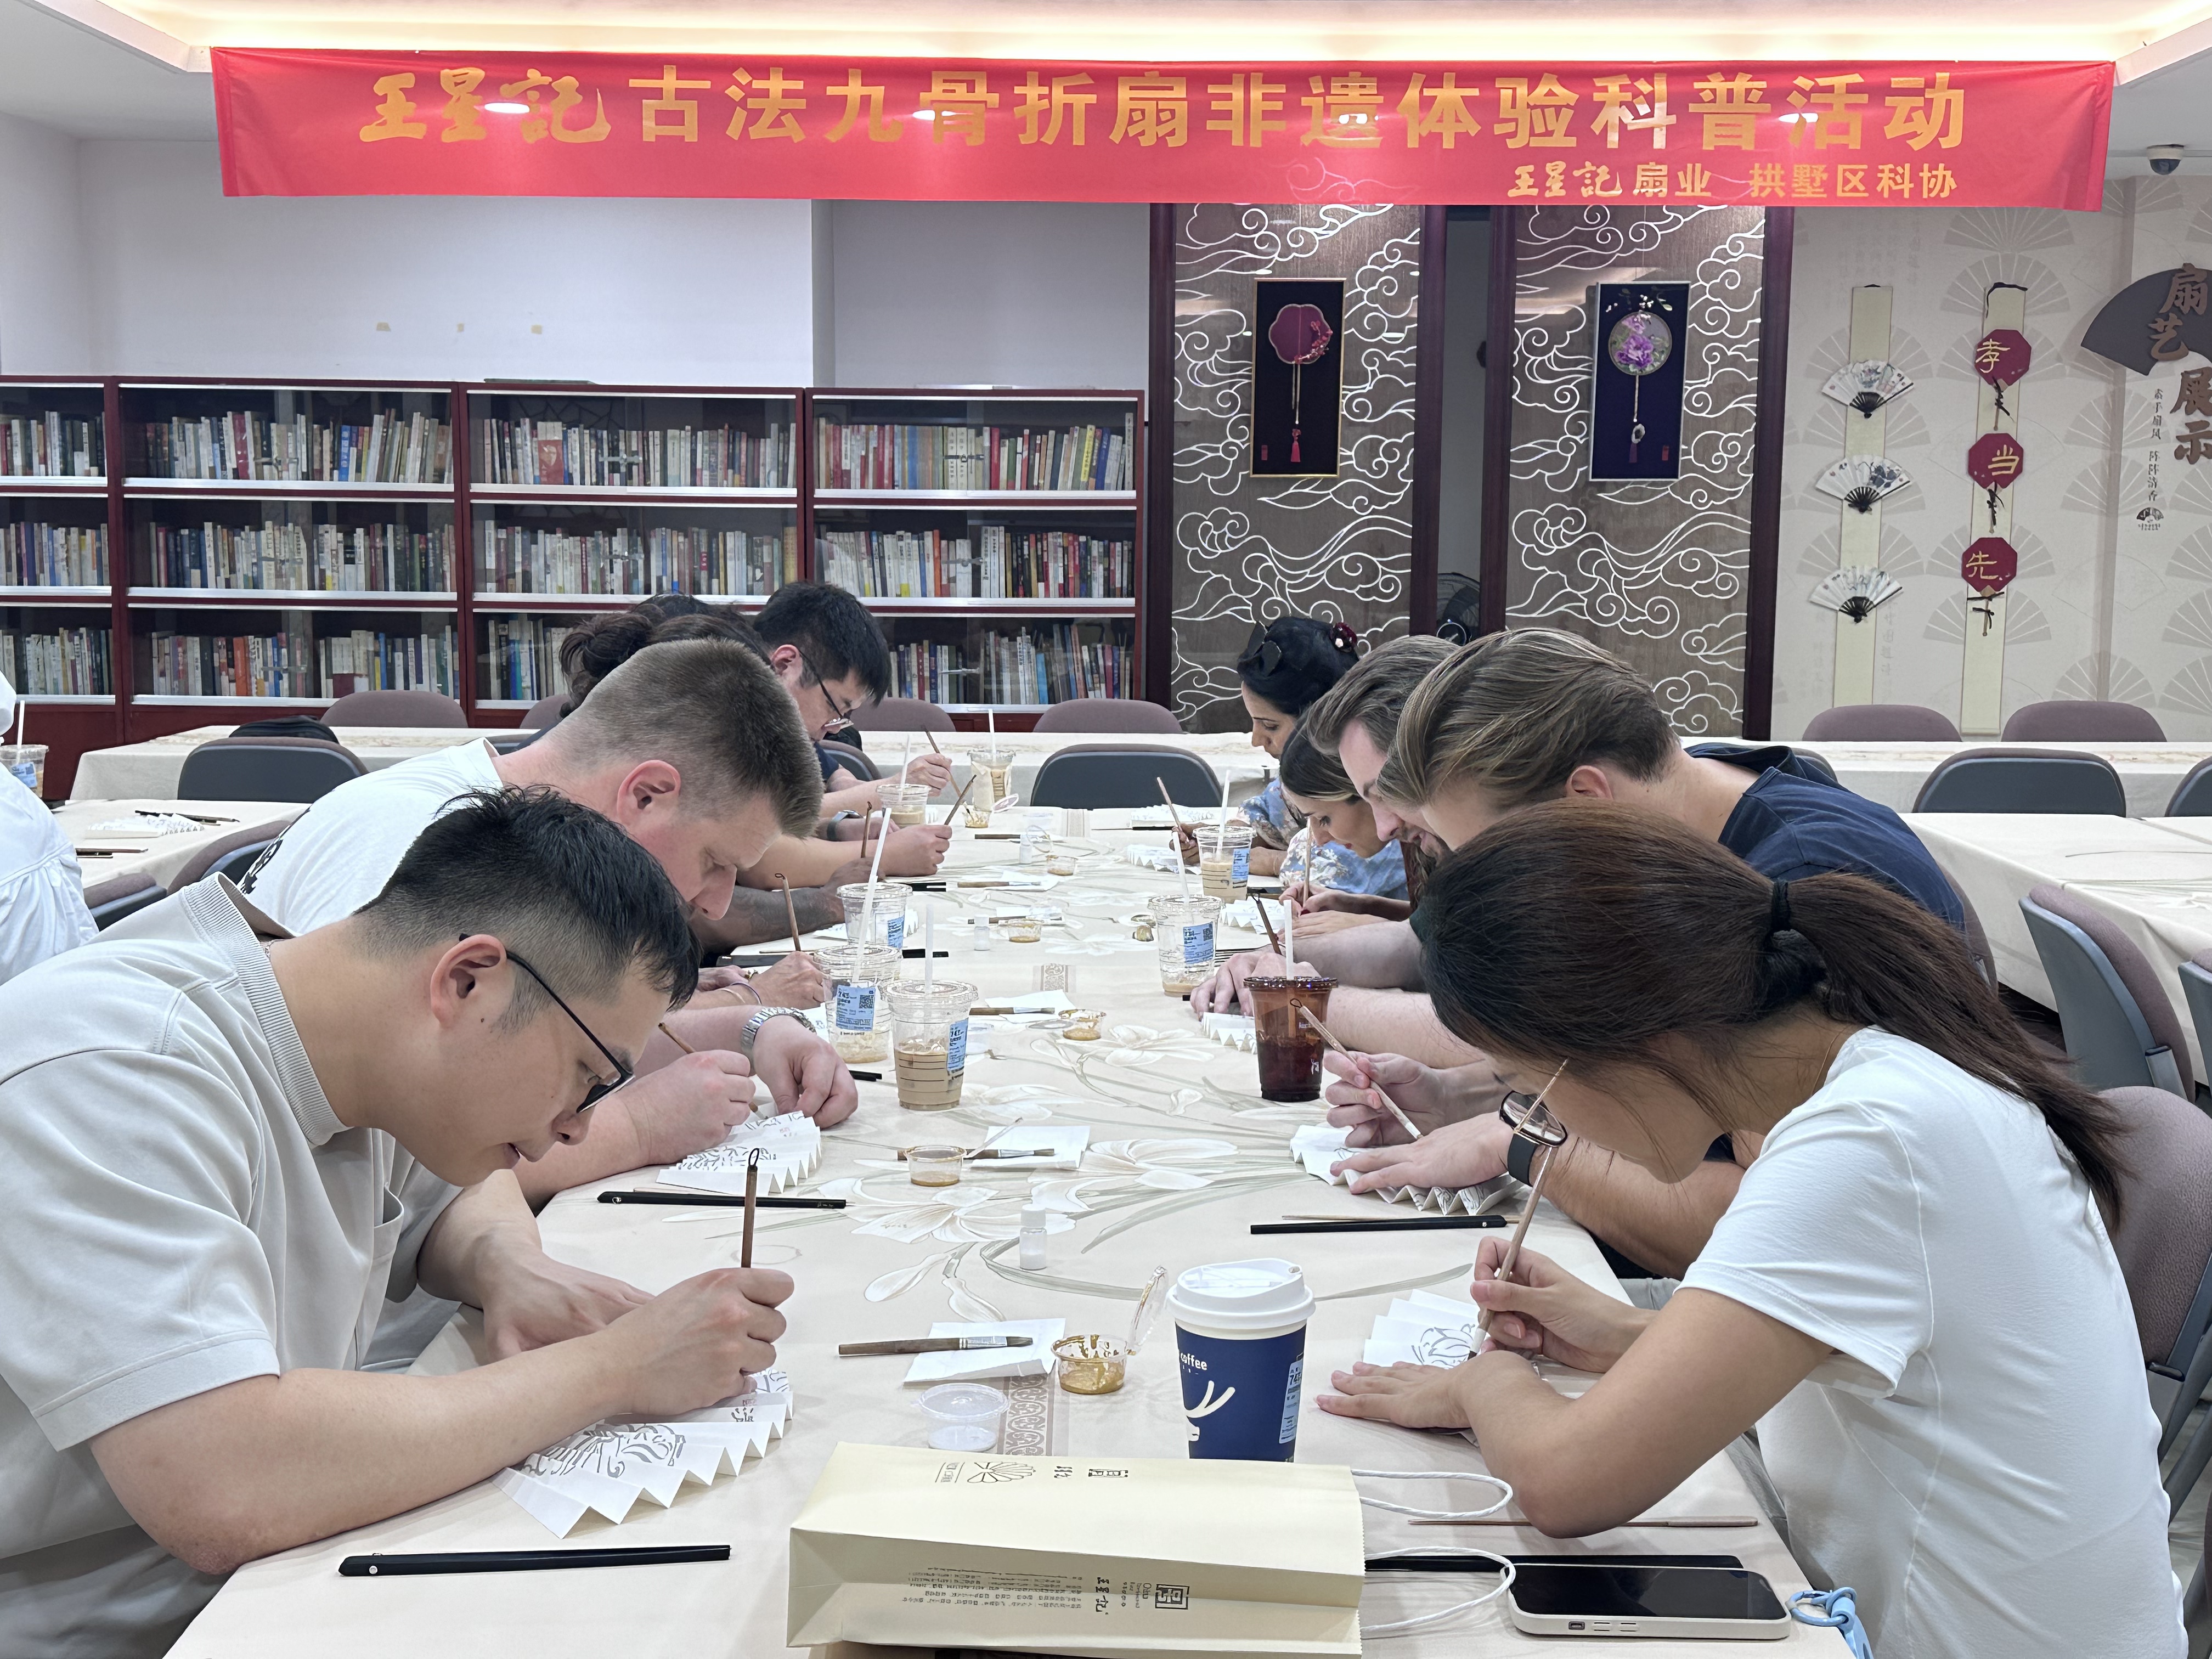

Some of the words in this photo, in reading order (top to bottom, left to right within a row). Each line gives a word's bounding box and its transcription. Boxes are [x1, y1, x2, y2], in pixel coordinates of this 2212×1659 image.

[1749, 162, 1957, 199] 拱墅区科协
[1975, 338, 2011, 374] 孝
[1988, 444, 2020, 476] 当
[1966, 550, 1999, 580] 先
